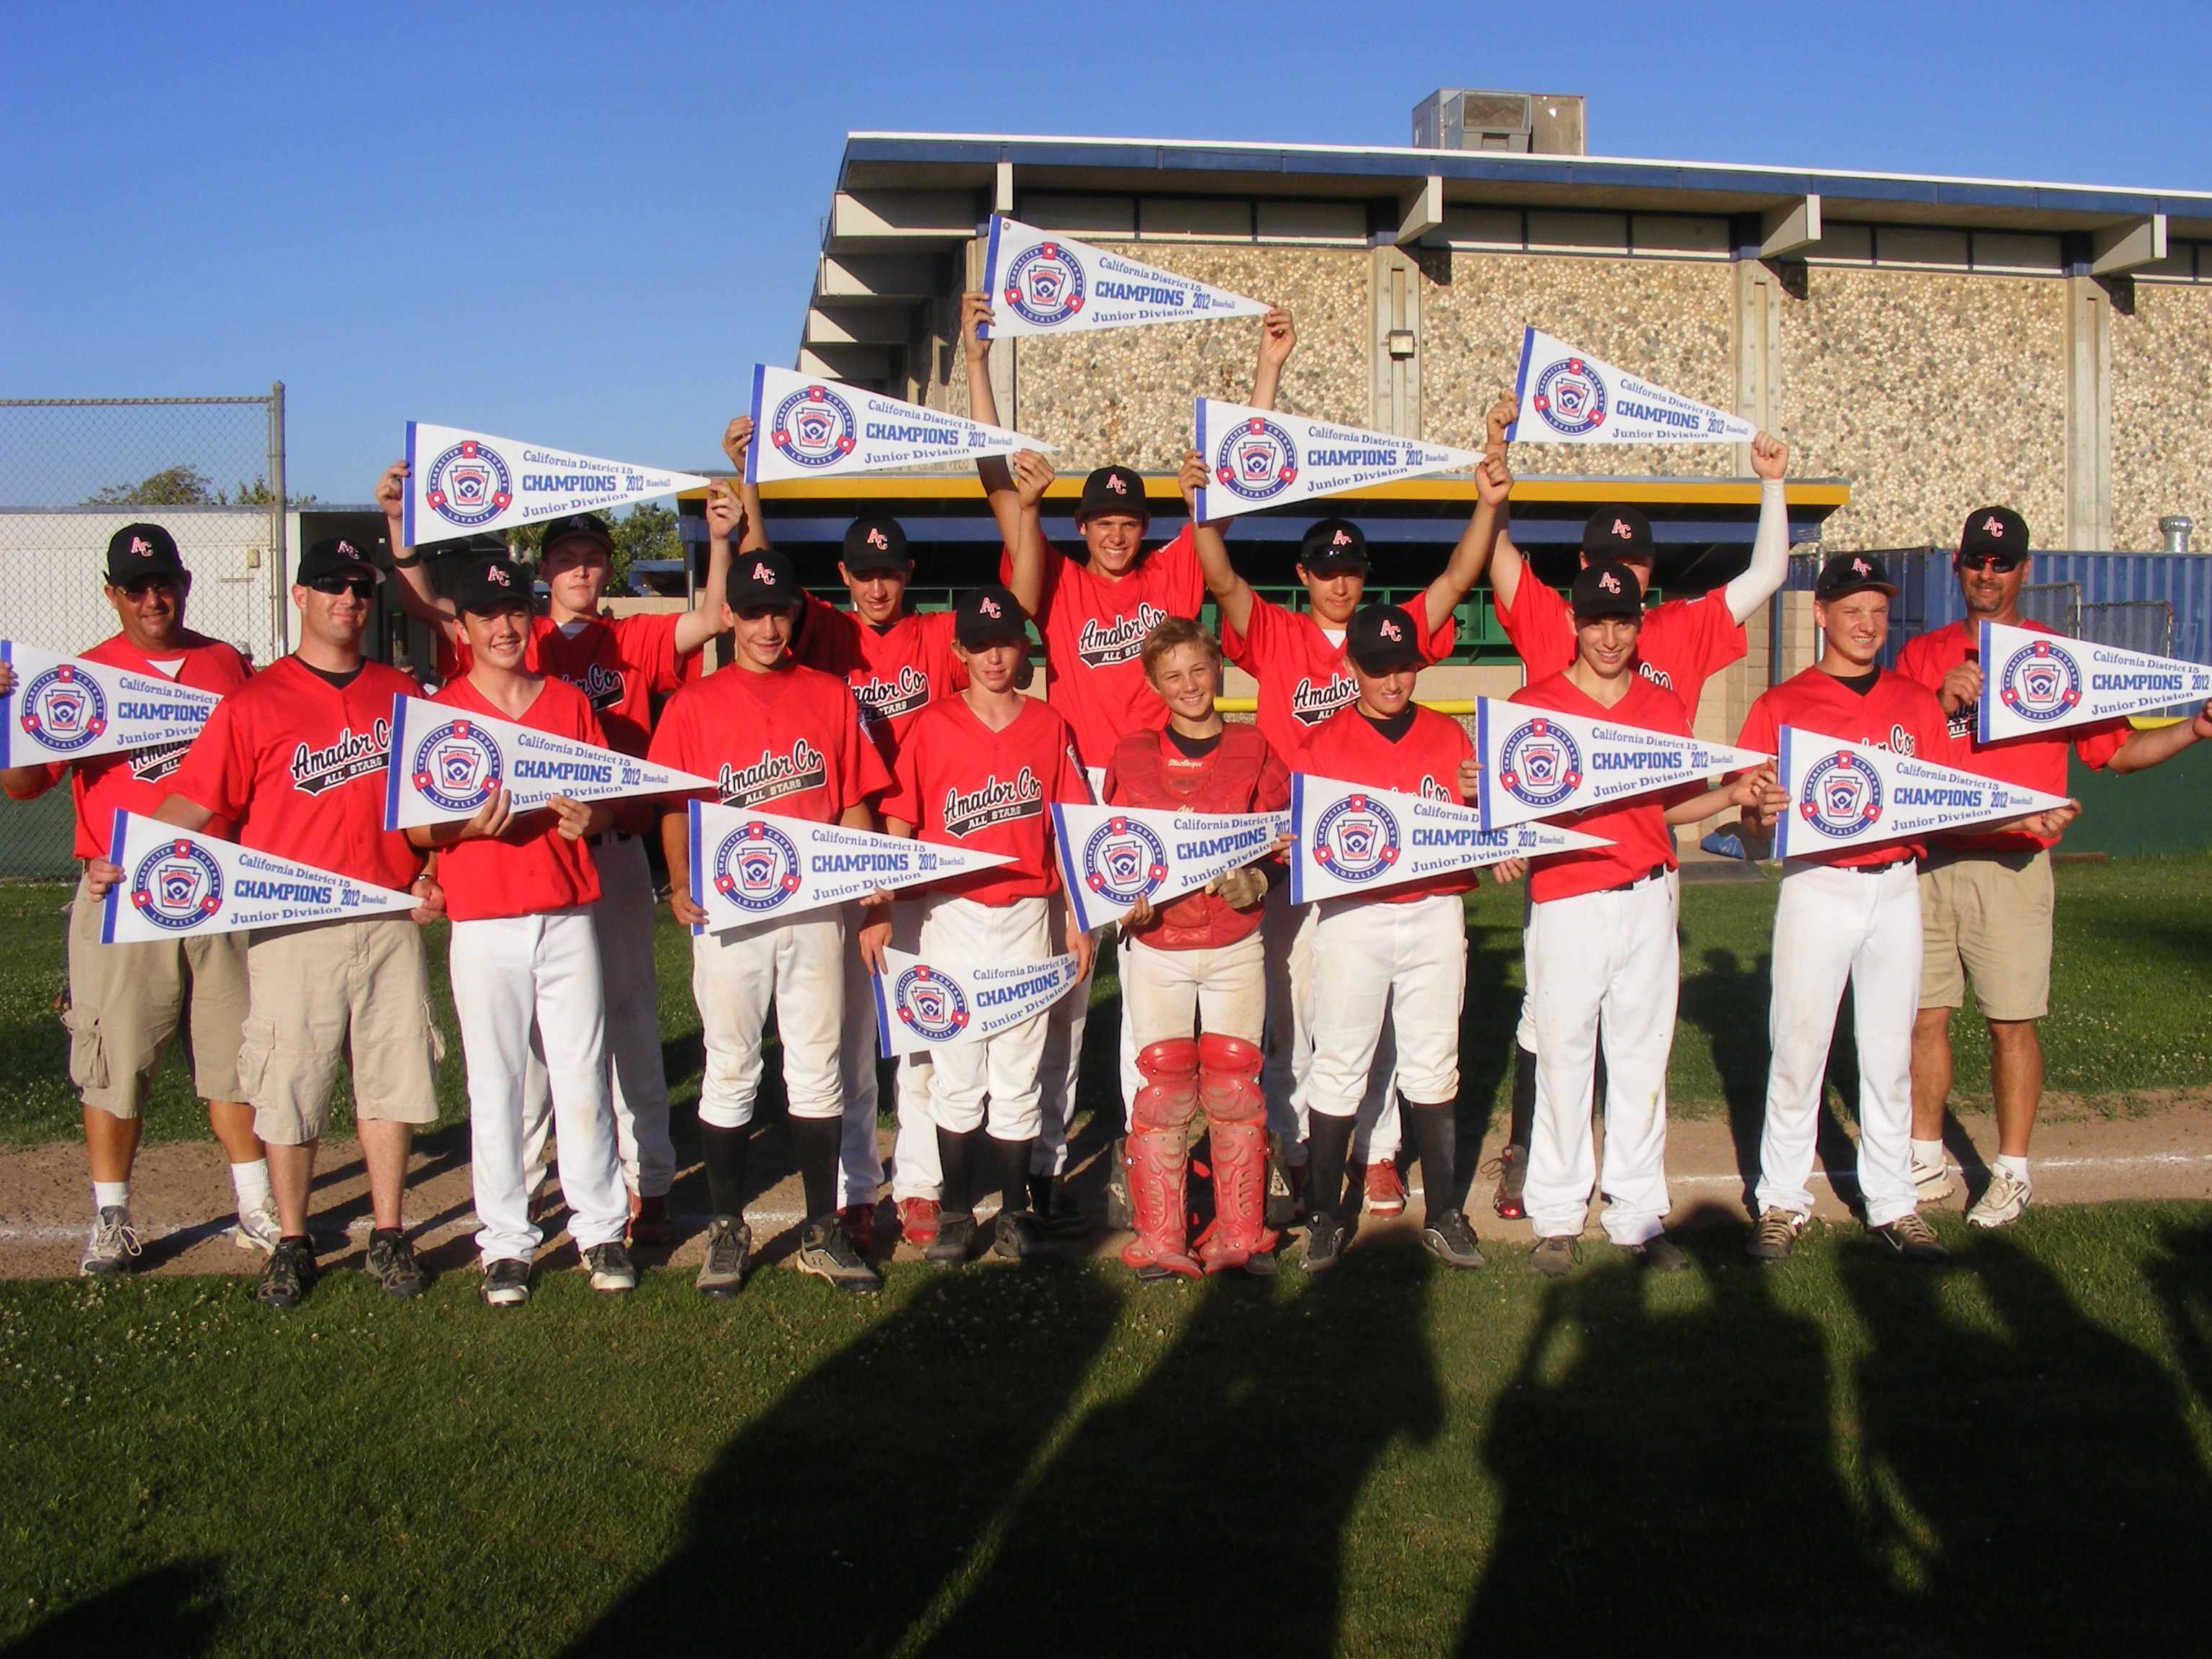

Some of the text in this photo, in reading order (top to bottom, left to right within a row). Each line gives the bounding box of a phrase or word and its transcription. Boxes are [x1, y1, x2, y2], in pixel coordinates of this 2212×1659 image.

[1100, 258, 1148, 279] California
[1151, 271, 1188, 288] District
[1096, 281, 1184, 306] CHAMPIONS
[1192, 294, 1210, 310] 2012
[1092, 307, 1194, 323] Junior Division
[1620, 379, 1667, 403] California
[1670, 397, 1704, 413] District
[868, 400, 920, 420] California
[922, 413, 961, 428] District
[1617, 400, 1699, 429] CHAMPIONS
[1707, 418, 1725, 434] 2012
[866, 423, 958, 445] CHAMPIONS
[968, 432, 986, 447] 2012
[1308, 427, 1359, 442] California
[1362, 434, 1399, 447] District
[1613, 428, 1653, 438] Junior
[523, 451, 577, 467] California
[579, 459, 619, 472] District
[865, 445, 970, 464] Junior Division
[1308, 450, 1396, 466] CHAMPIONS
[1406, 450, 1423, 465] 2012
[523, 475, 616, 491] CHAMPIONS
[626, 475, 644, 491] 2012
[1308, 468, 1407, 492] Junior Division
[523, 494, 628, 518] Junior Division
[1079, 614, 1146, 650] Amador
[1102, 652, 1121, 661] ALL
[2093, 651, 2145, 667] California
[2148, 660, 2185, 672] District
[120, 678, 212, 703] California District
[1292, 673, 1360, 709] Amador
[2092, 675, 2209, 690] CHAMPIONS 2012
[118, 703, 209, 721] CHAMPIONS
[2092, 691, 2193, 715] Junior Division
[117, 725, 202, 745] Junior Divis
[1592, 727, 1644, 744] California
[1646, 736, 1683, 749] District
[291, 728, 375, 780] Amador
[518, 734, 572, 755] California
[575, 747, 616, 764] District
[325, 756, 382, 786] ALL STARS
[1593, 752, 1682, 770] CHAMPIONS
[1691, 752, 1708, 768] 2012
[514, 760, 611, 783] CHAMPIONS
[621, 769, 641, 786] 2012
[719, 750, 793, 799] Amador
[1593, 770, 1693, 797] Junior Division
[1897, 763, 1946, 781] California
[1948, 773, 1985, 788] District
[433, 793, 479, 807] LOYALTY
[562, 786, 622, 800] Division
[745, 778, 801, 805] ALL STARS
[943, 775, 1017, 823] Amador
[1894, 788, 1982, 806] CHAMPIONS
[1990, 792, 2008, 808] 2012
[968, 806, 1021, 829] ALL STARS
[1174, 819, 1229, 830] California
[1232, 817, 1267, 828] District
[1414, 804, 1468, 822] California
[1892, 806, 1993, 831] Junior Division
[812, 830, 867, 846] California
[870, 838, 911, 851] District
[1177, 829, 1267, 859] CHAMPIONS
[1413, 830, 1508, 846] CHAMPIONS
[1518, 832, 1537, 847] 2012
[239, 854, 293, 876] California
[295, 868, 336, 885] District
[812, 854, 909, 872] CHAMPIONS
[918, 854, 937, 870] 2012
[1334, 866, 1378, 878] LOYALTY
[1412, 849, 1519, 873] Junior Division
[813, 873, 921, 900] Junior Division
[1182, 866, 1226, 886] Junior
[234, 880, 331, 904] CHAMPIONS
[341, 889, 360, 907] 2012
[737, 895, 780, 907] LOYALTY
[153, 912, 197, 926] LOYALTY
[230, 904, 343, 925] Junior Division
[974, 968, 1025, 980] California
[1028, 961, 1059, 974] District
[976, 971, 1060, 1007] CHAMPIONS
[981, 983, 1071, 1031] Junior Division
